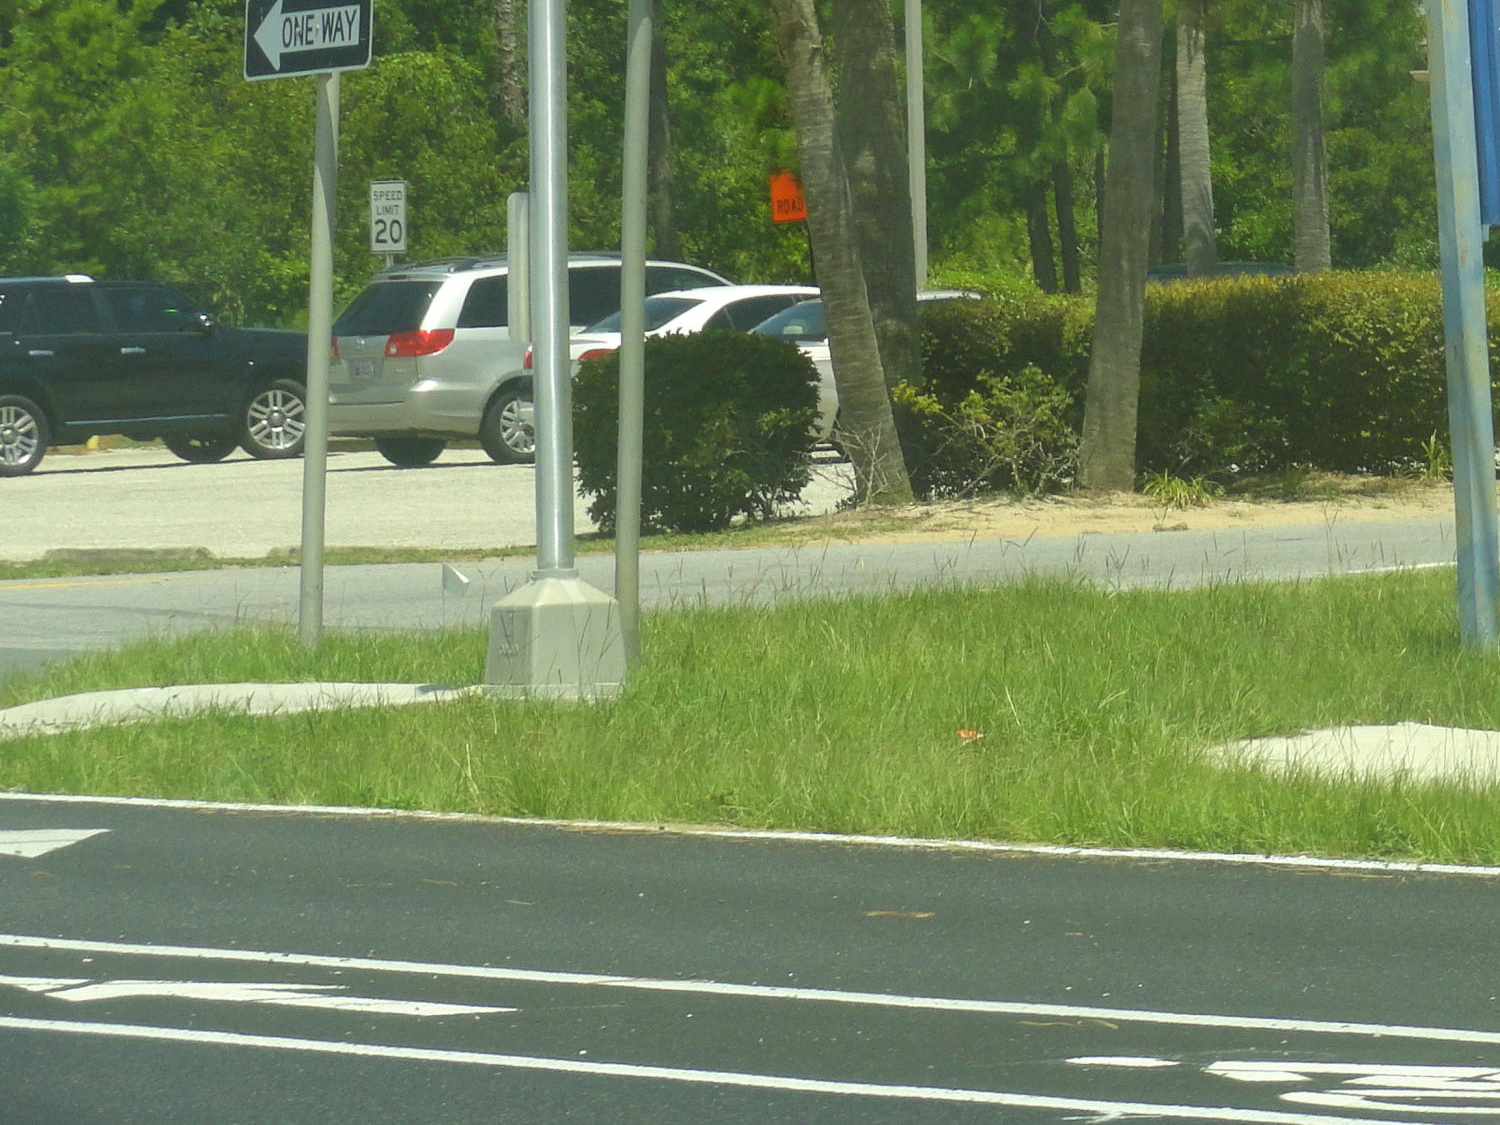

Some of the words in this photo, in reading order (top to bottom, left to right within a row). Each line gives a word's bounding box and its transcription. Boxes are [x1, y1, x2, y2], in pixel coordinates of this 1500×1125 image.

[282, 13, 315, 48] ONE
[321, 8, 358, 44] WAY
[373, 189, 402, 202] SPEED
[376, 204, 399, 216] LIMIT
[374, 218, 402, 244] 20
